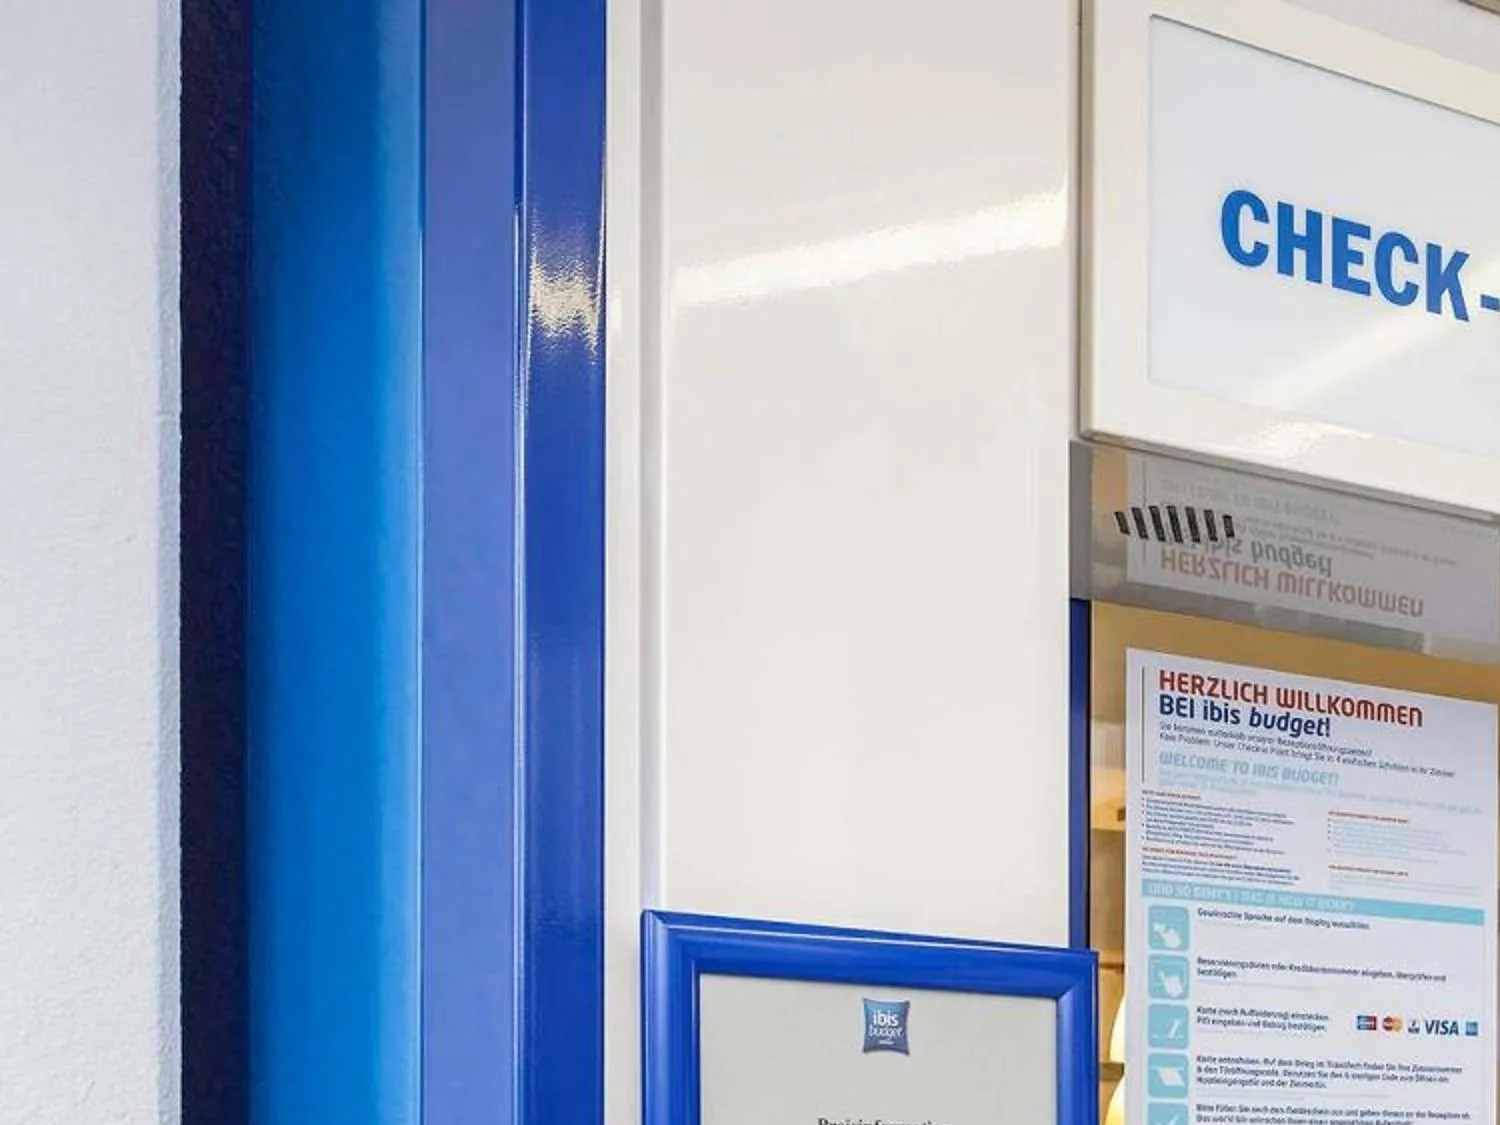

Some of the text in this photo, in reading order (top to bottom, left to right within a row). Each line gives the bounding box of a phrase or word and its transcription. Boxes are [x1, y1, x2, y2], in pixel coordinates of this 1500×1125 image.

[1159, 669, 1423, 727] HERZLICH WILLKOMMEN
[1159, 693, 1331, 738] BEI ibis budget!
[1159, 751, 1340, 787] WELCOME TO IBIS BUDGET!
[872, 1009, 899, 1027] ibis
[1424, 1019, 1460, 1036] VISA
